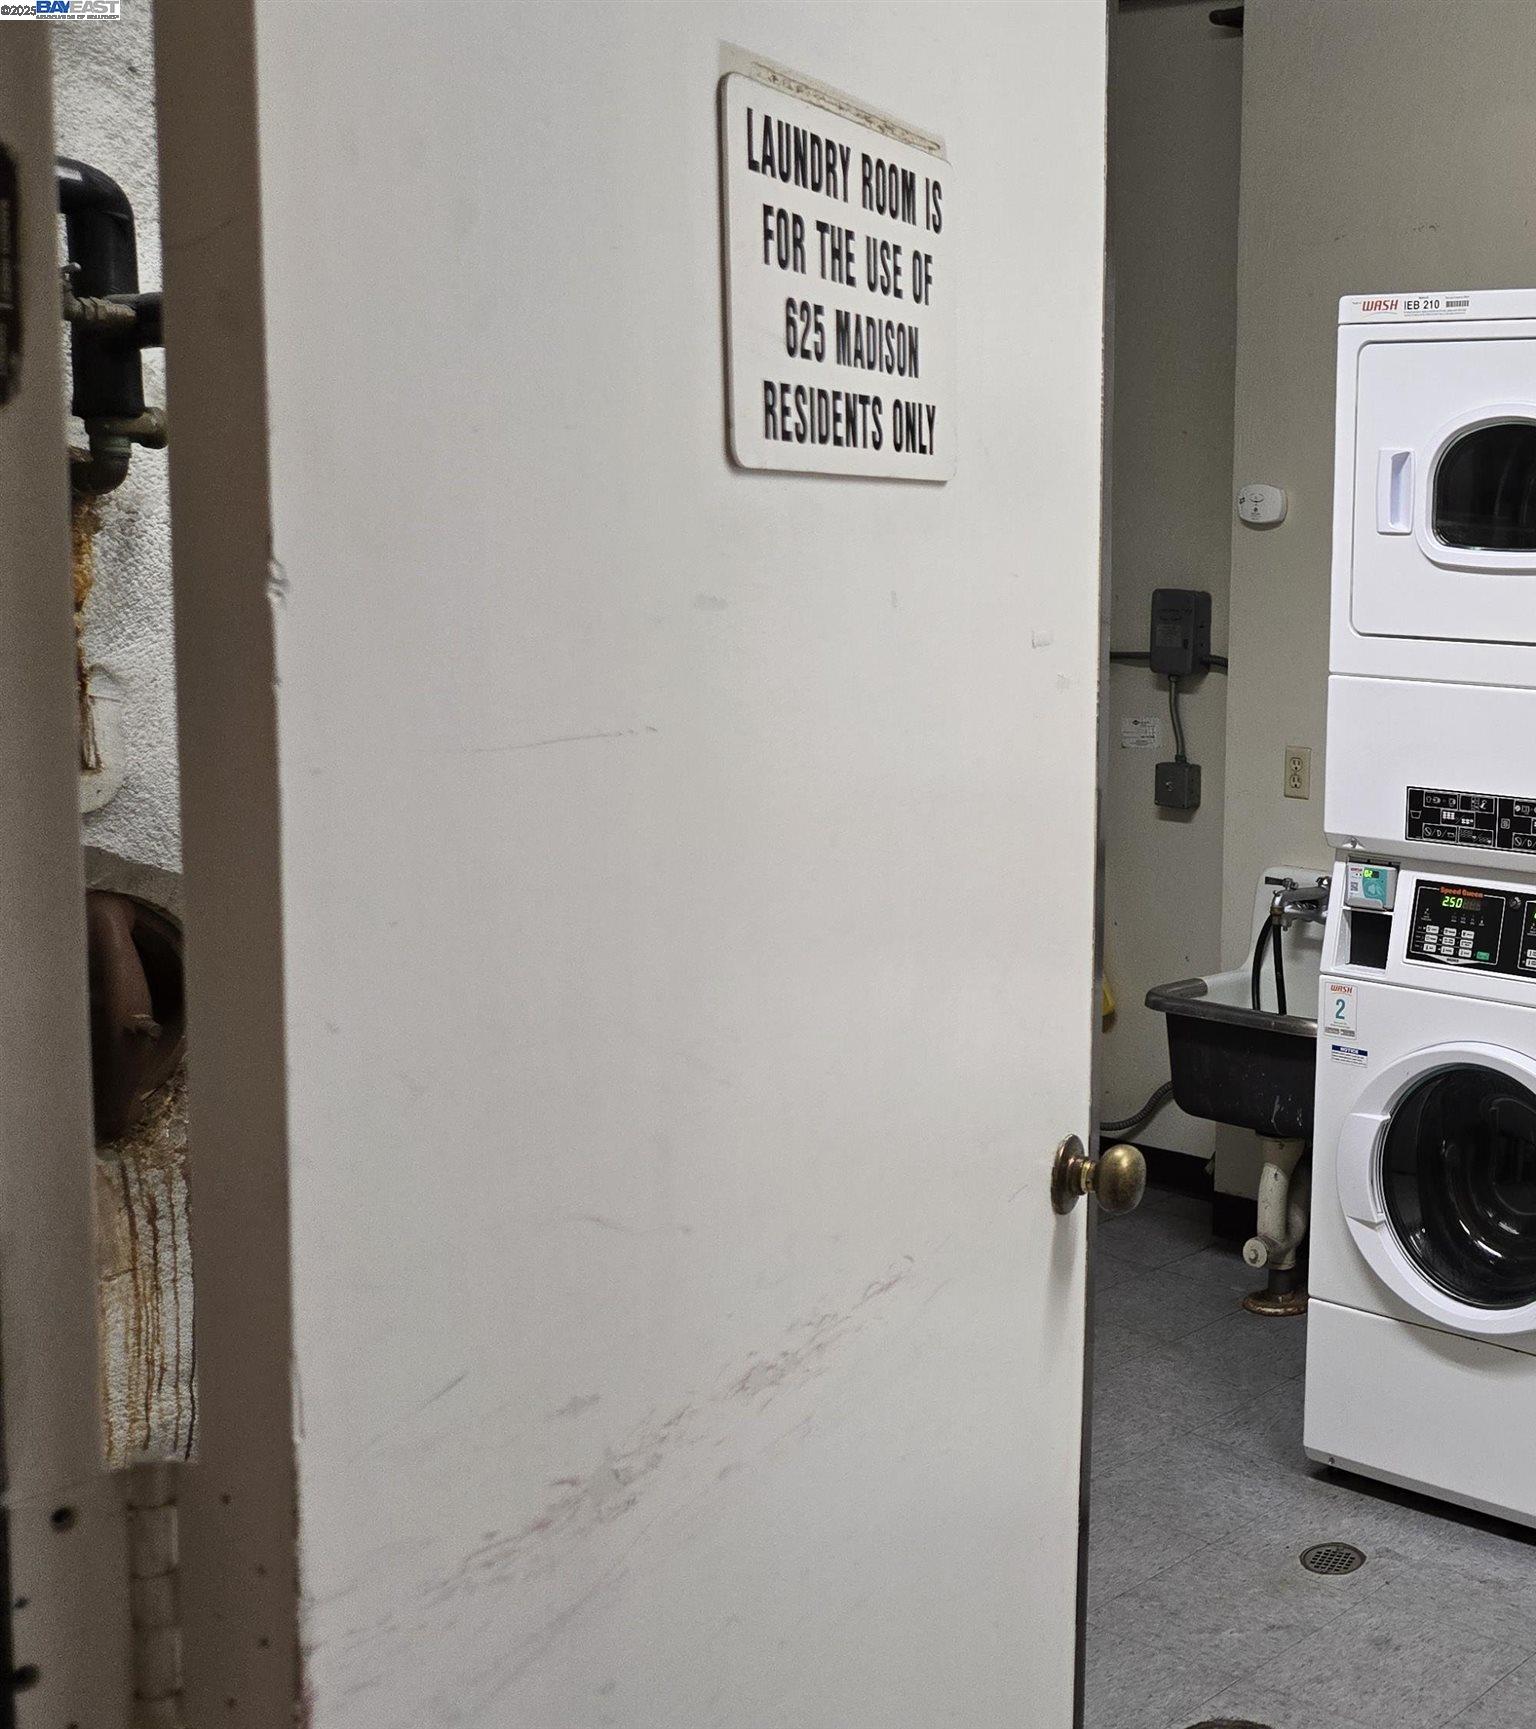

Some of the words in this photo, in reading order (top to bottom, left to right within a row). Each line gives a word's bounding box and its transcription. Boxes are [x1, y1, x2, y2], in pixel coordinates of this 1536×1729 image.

[747, 107, 850, 204] LAUNDRY
[862, 152, 916, 227] ROOM
[926, 177, 943, 234] IS
[762, 203, 806, 275] FOR
[816, 220, 857, 288] THE
[866, 236, 903, 299] USE
[912, 249, 933, 305] OF
[1362, 299, 1398, 311] WASH
[1404, 300, 1420, 310] IEB
[1423, 299, 1440, 309] 210
[785, 297, 825, 362] 625
[835, 309, 919, 379] MADISON
[762, 379, 883, 452] RESIDENTS
[892, 398, 936, 455] ONLY
[1440, 886, 1462, 898] Speed
[1462, 888, 1484, 899] Queen
[1330, 984, 1353, 994] WASH
[1335, 998, 1346, 1020] 2
